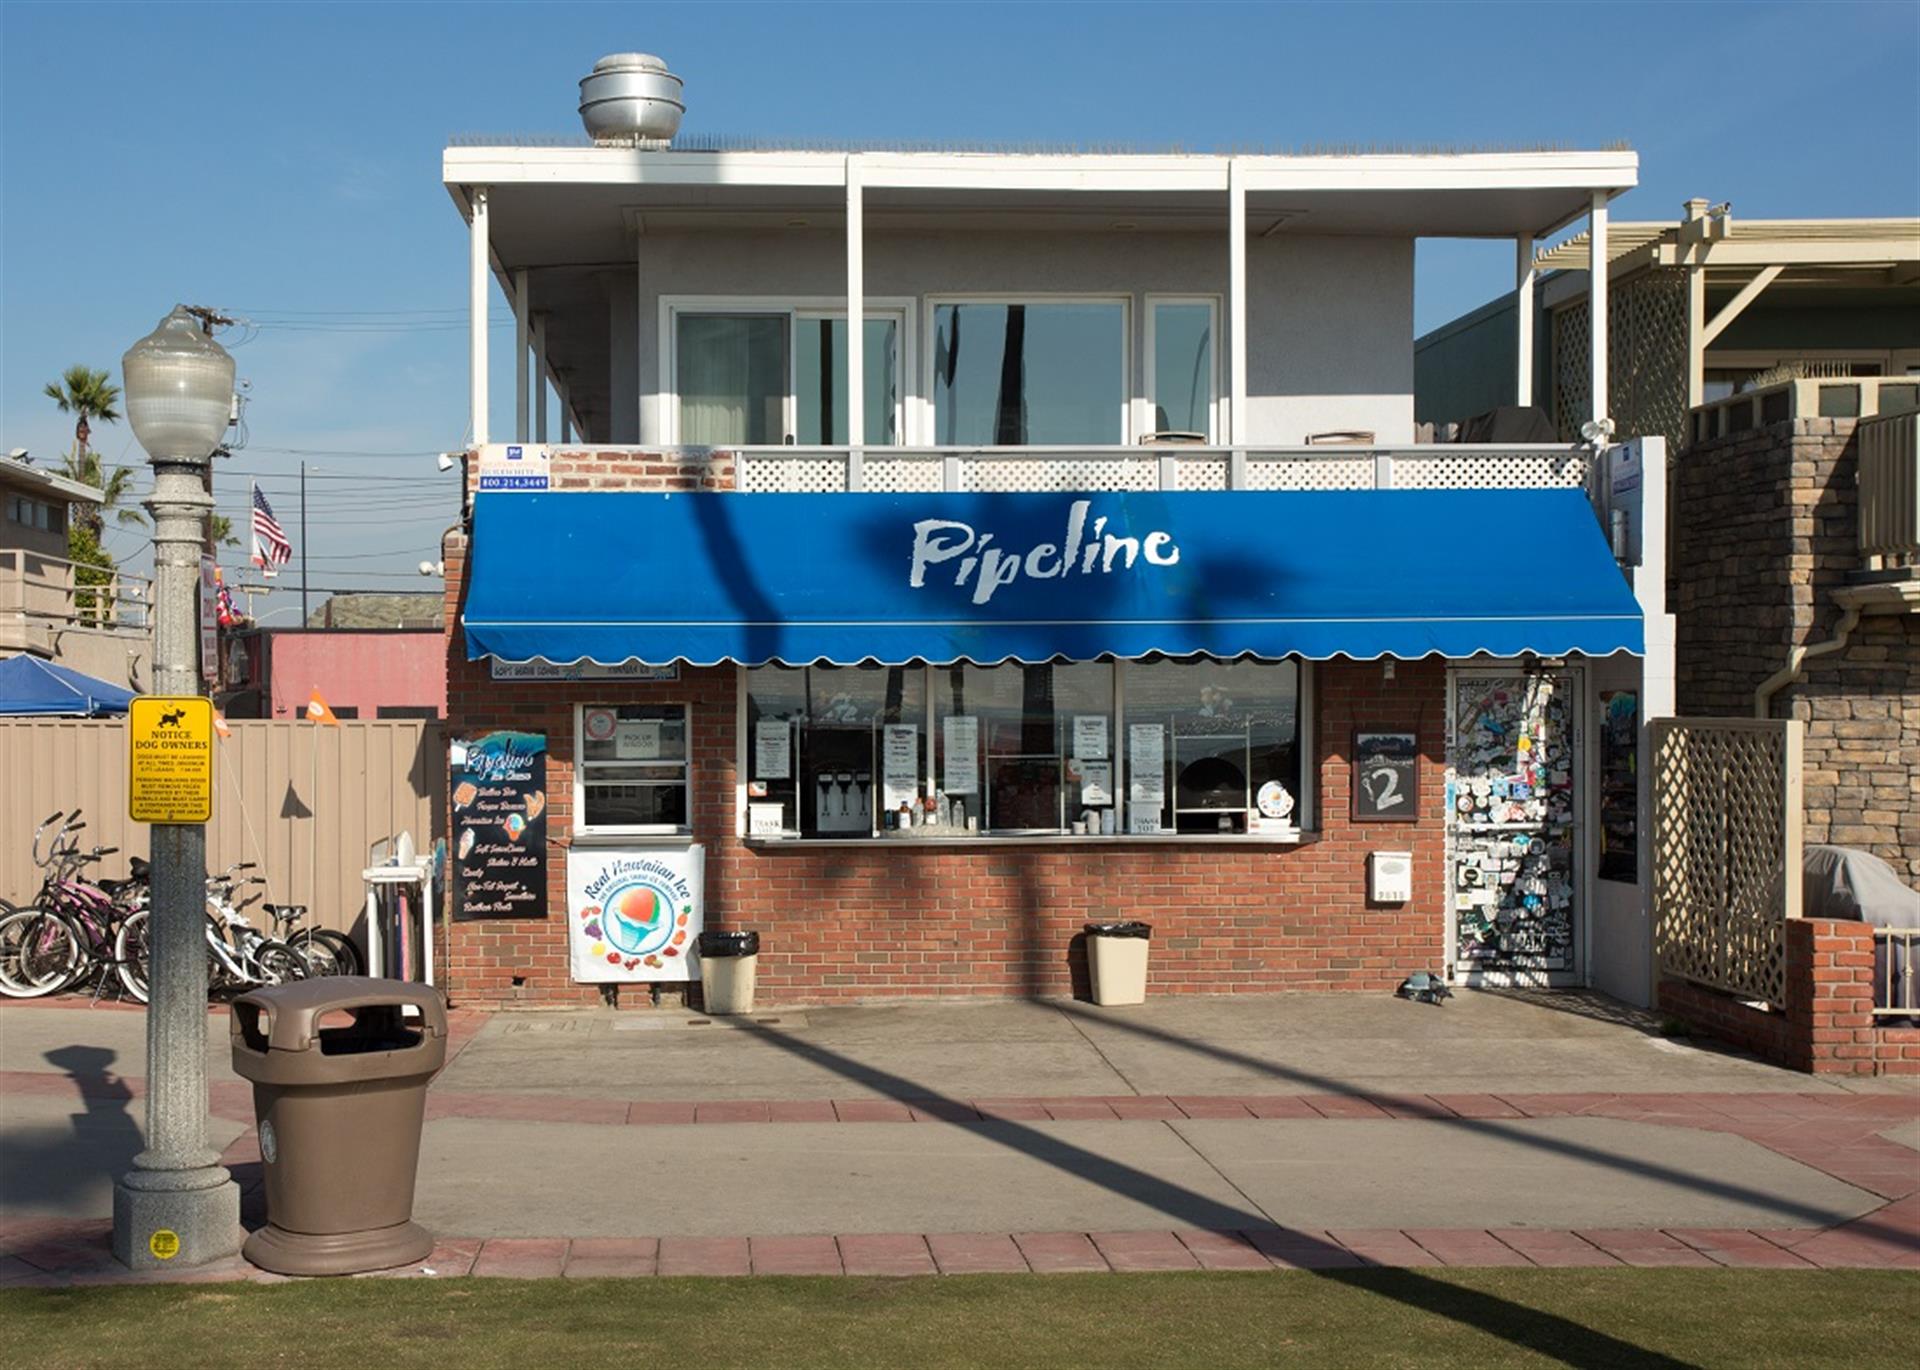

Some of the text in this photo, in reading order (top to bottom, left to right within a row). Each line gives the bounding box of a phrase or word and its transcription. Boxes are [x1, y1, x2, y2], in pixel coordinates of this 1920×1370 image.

[909, 500, 1181, 605] Pipeline
[135, 741, 208, 750] DOG OWNERS
[151, 730, 192, 740] NOTICE
[464, 737, 533, 780] Pipeline
[584, 859, 691, 900] Real Hawaiian Ice
